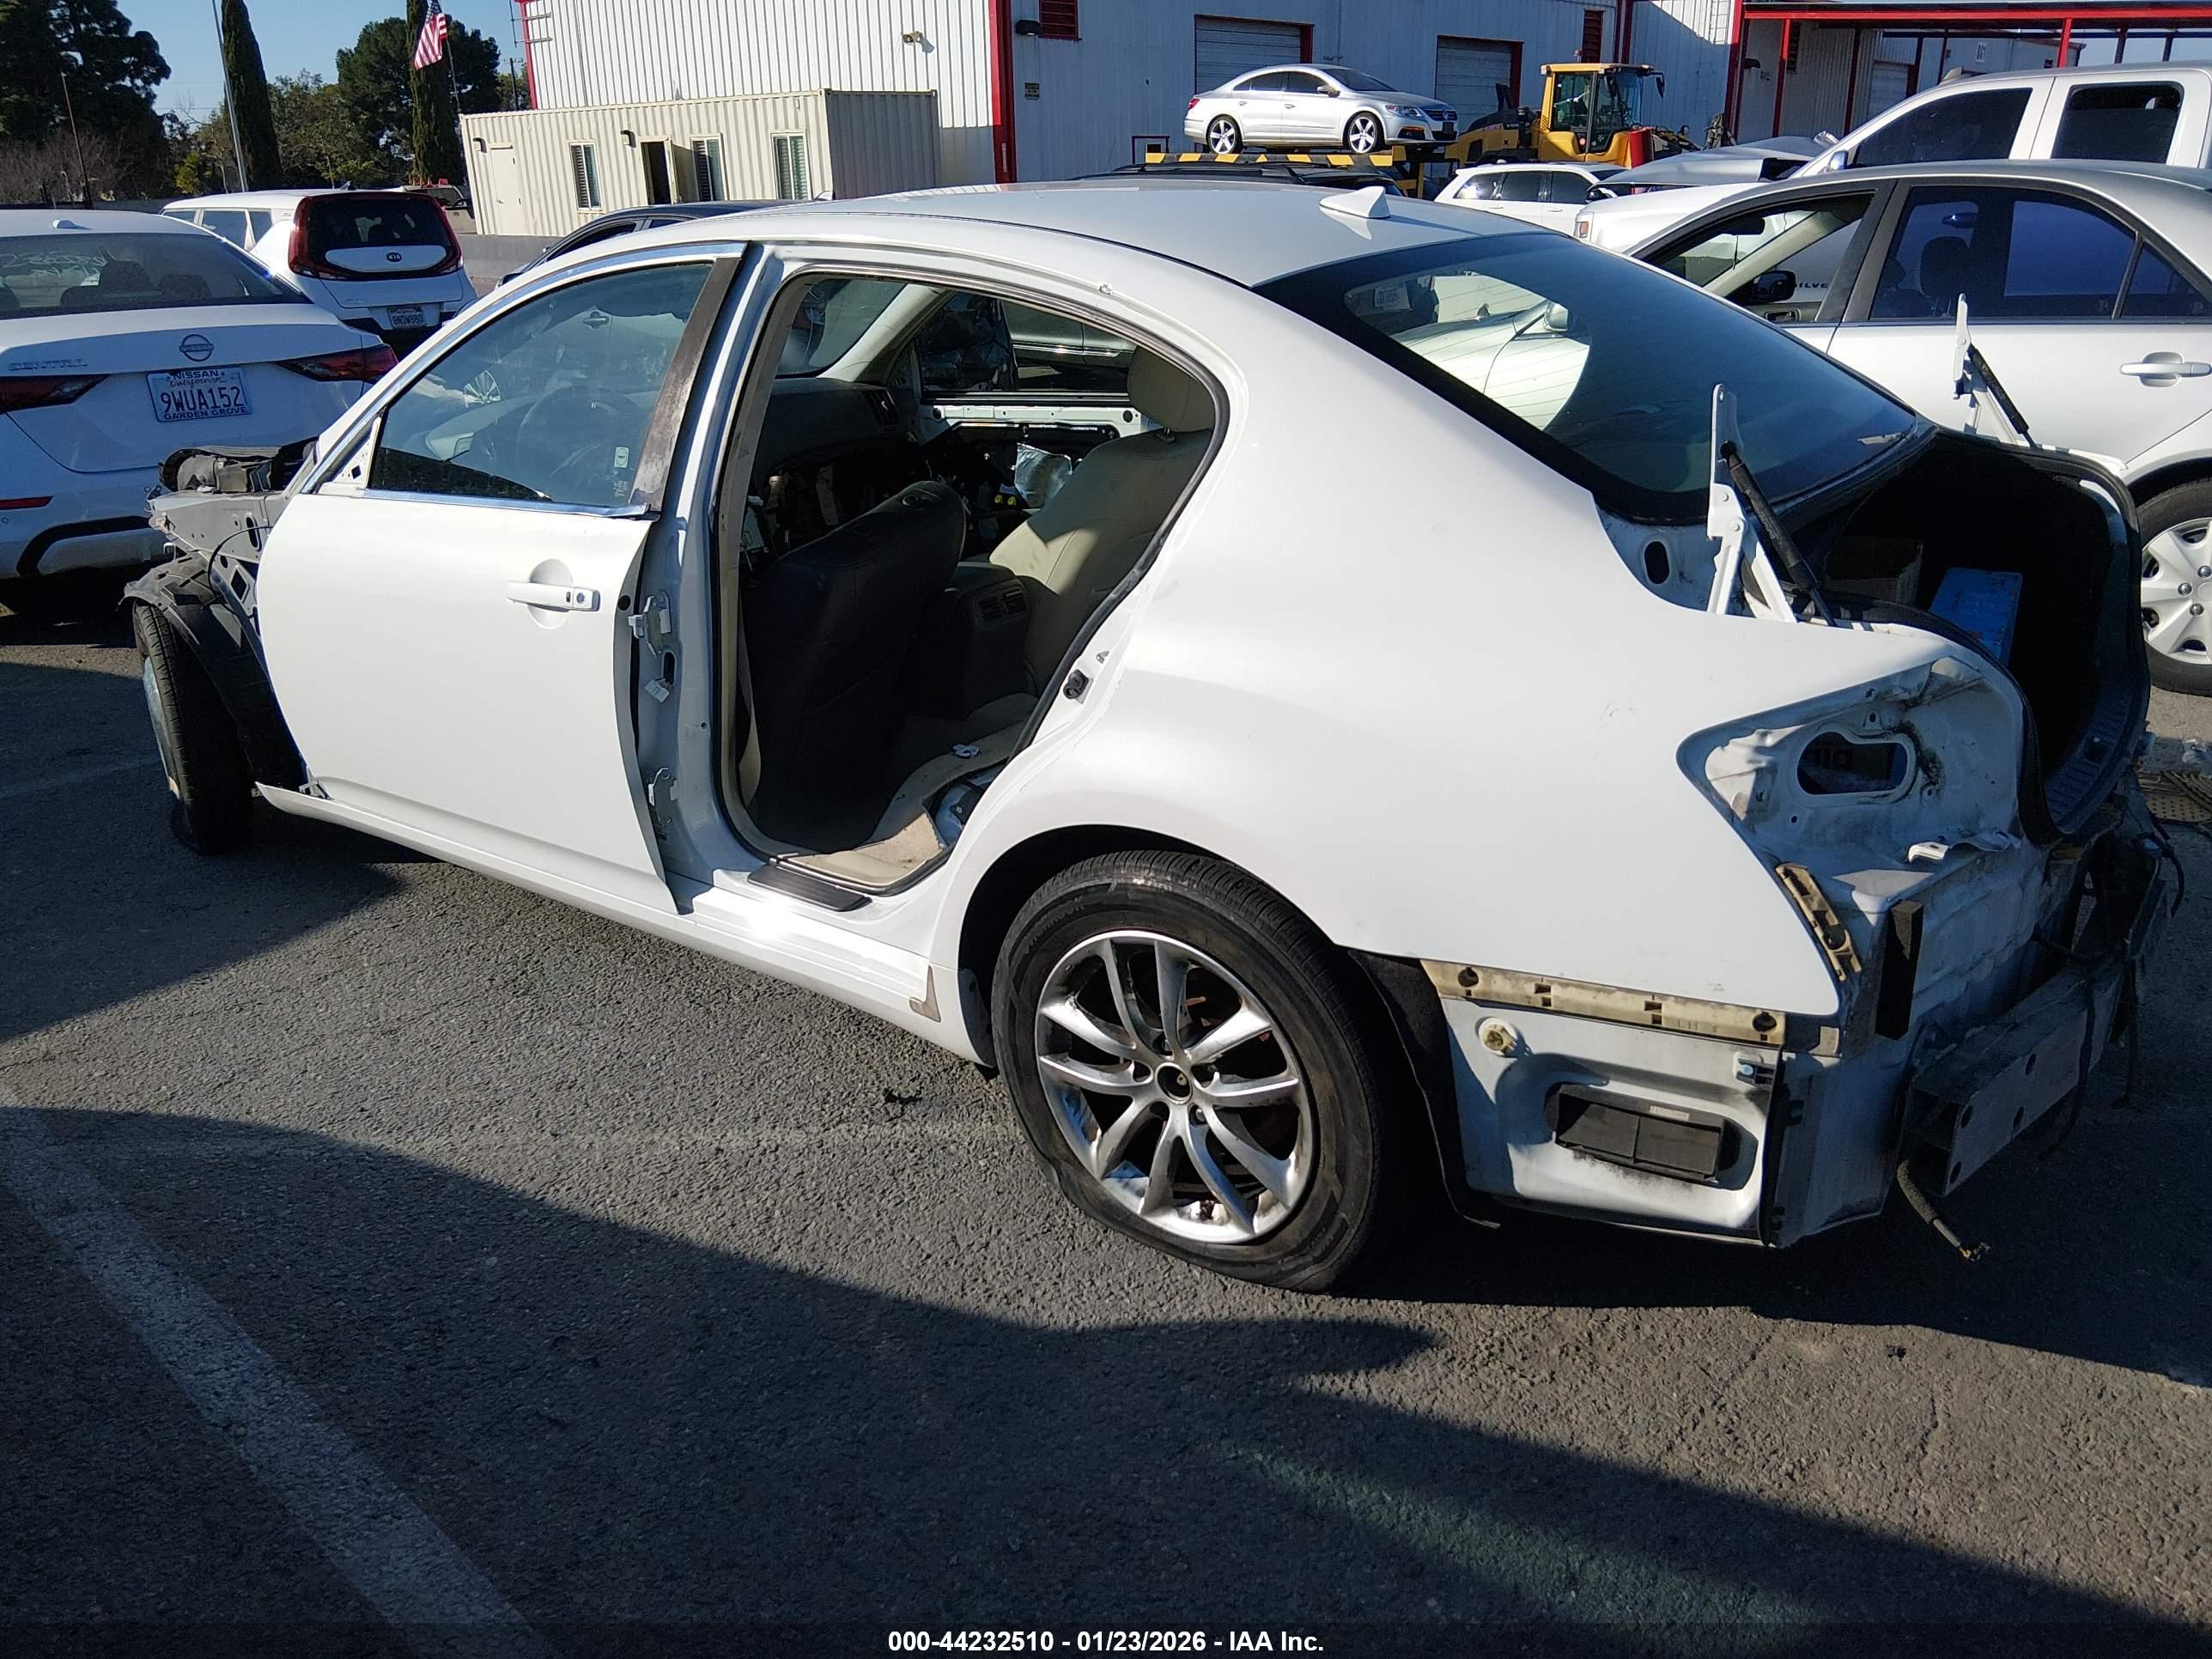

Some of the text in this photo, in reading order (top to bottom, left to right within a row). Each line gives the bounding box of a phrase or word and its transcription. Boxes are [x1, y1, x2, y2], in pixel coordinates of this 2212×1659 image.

[387, 252, 401, 261] KIA
[8, 358, 88, 371] SENTRA
[173, 370, 219, 379] NISSAN
[161, 386, 244, 413] 9WUA152
[164, 406, 247, 420] GARDEN GROVE
